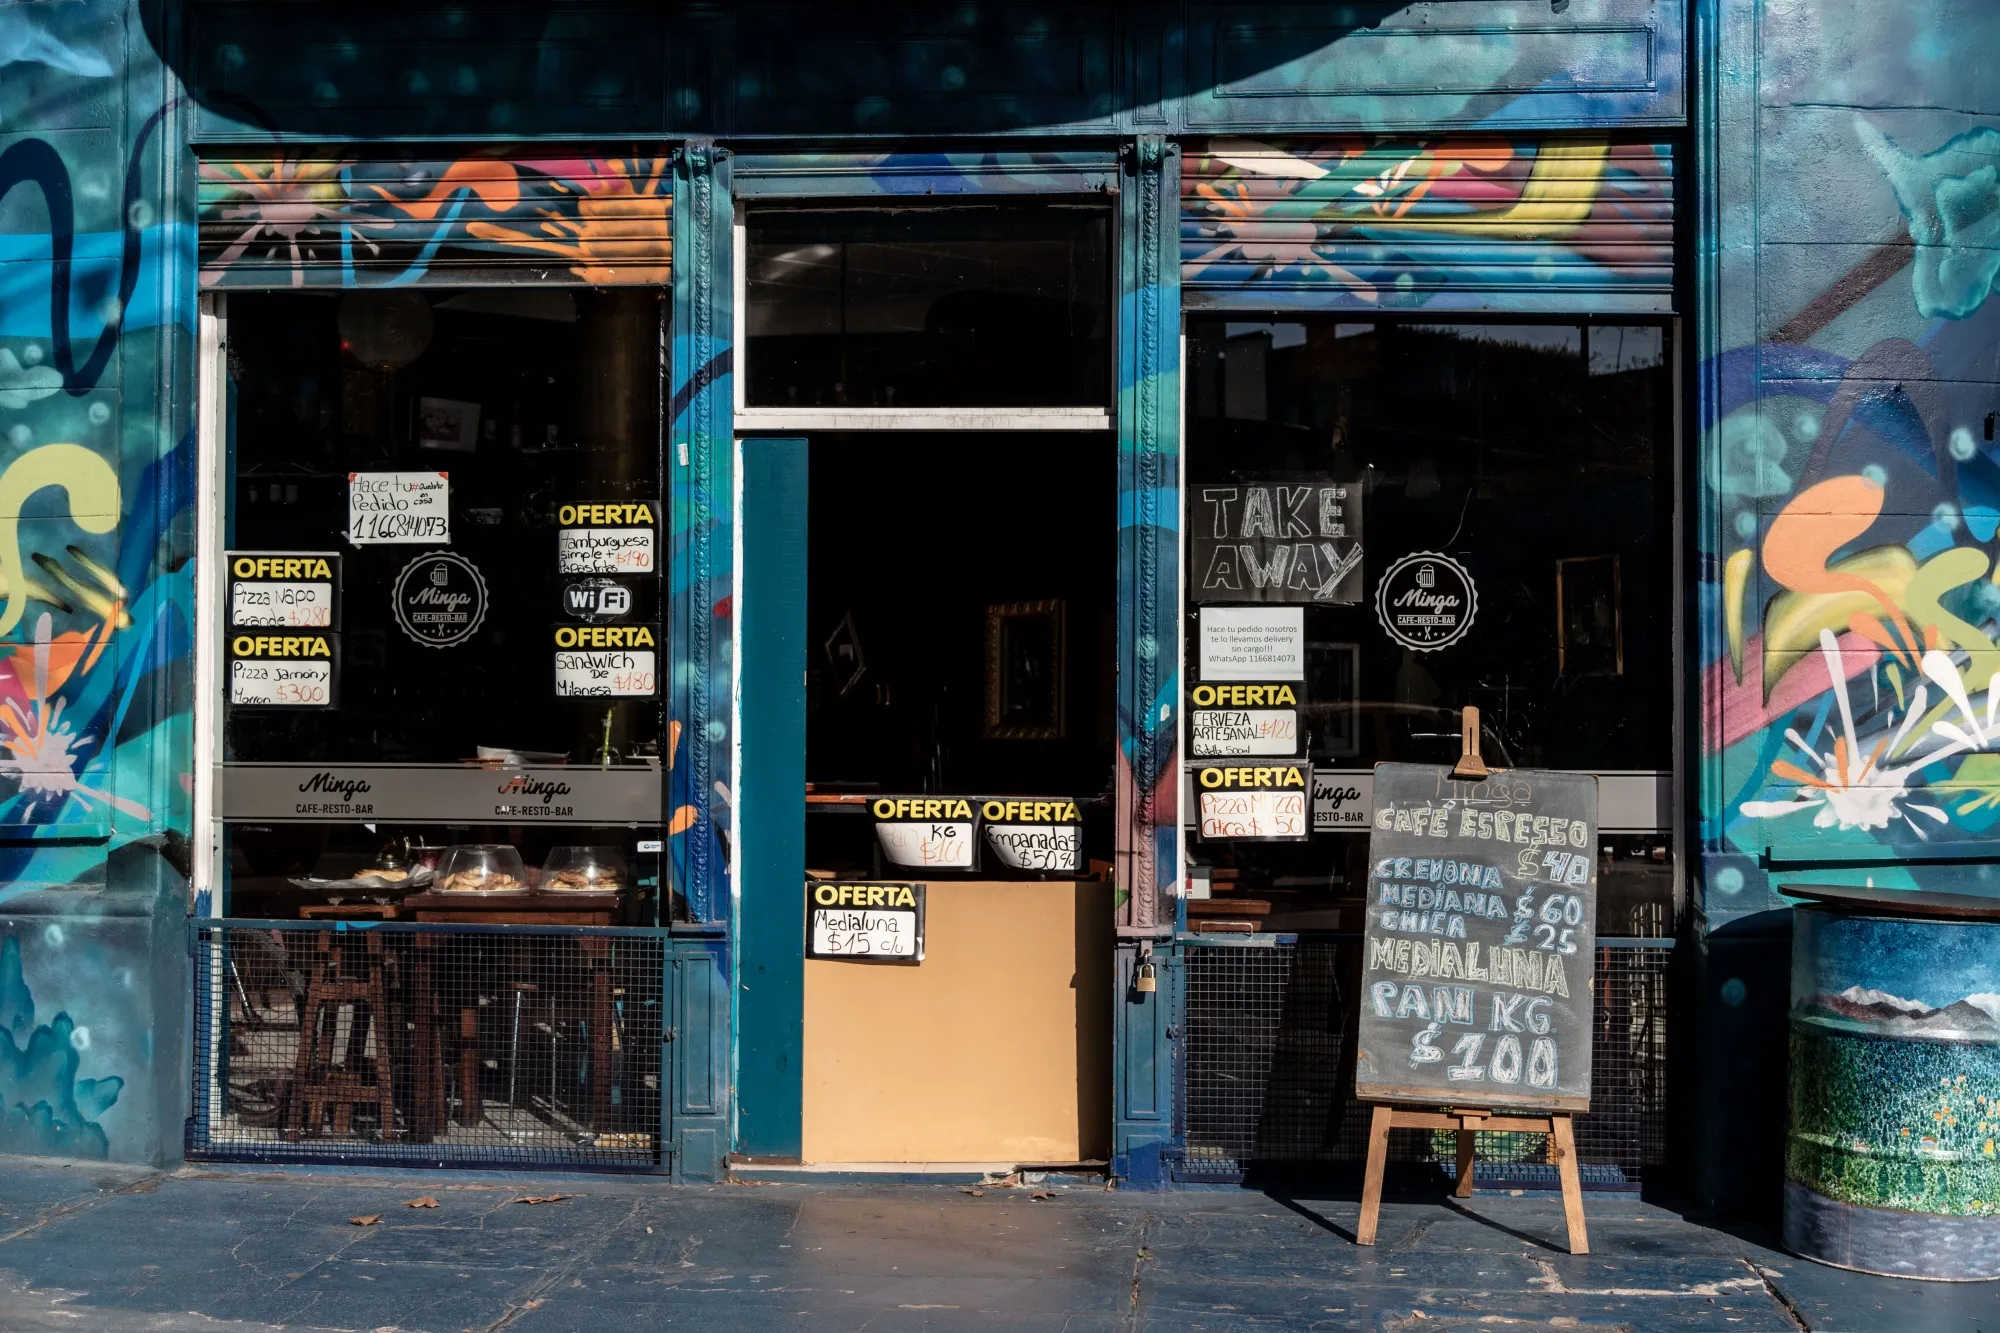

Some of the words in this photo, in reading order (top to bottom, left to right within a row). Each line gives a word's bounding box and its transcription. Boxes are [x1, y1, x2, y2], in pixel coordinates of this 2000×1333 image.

[353, 476, 389, 492] Hace
[393, 475, 412, 492] tu
[352, 493, 408, 511] Pedido
[414, 497, 433, 505] casa
[559, 504, 654, 525] OFERTA
[1203, 486, 1347, 538] TAKE
[560, 530, 649, 550] Hamburguesa
[560, 547, 602, 562] simple
[615, 550, 649, 567] $190
[234, 558, 332, 578] OFERTA
[1203, 542, 1363, 600] AWAY
[234, 583, 271, 606] Pizza
[275, 588, 316, 608] Napo
[409, 587, 471, 612] Minga
[1393, 588, 1460, 615] Minga
[233, 608, 286, 627] Grande
[555, 627, 655, 647] OFERTA
[1220, 635, 1228, 643] lo
[1229, 635, 1262, 643] llevamos
[1263, 635, 1294, 644] delivery
[1237, 625, 1263, 634] pedido
[233, 636, 331, 657] OFERTA
[1231, 645, 1242, 653] sin
[1243, 645, 1273, 654] cargo!!!
[556, 652, 634, 670] Sandwich
[1208, 655, 1247, 664] WhatsApp
[1249, 655, 1296, 663] 1166814073
[234, 662, 269, 680] Pizza
[557, 681, 612, 696] Milanesa
[613, 672, 655, 691] $180
[277, 684, 323, 703] $300
[1192, 685, 1296, 706] OFERTA
[1193, 712, 1251, 727] CERVEZA
[1259, 718, 1296, 740] $120
[1193, 724, 1265, 741] ARTESANAL
[299, 772, 371, 802] Minga
[1200, 767, 1304, 788] OFERTA
[498, 774, 571, 804] Minga
[1313, 779, 1361, 810] inga
[1436, 769, 1532, 809] Minga
[296, 804, 373, 814] CAFE-RESTO-BAR
[495, 806, 574, 816] CAFE-RESTO-BAR
[874, 799, 973, 819] OFERTA
[982, 801, 1082, 822] OFERTA
[1201, 793, 1248, 815] Pizza
[931, 824, 957, 841] KG
[985, 826, 1083, 853] Empanadas
[1018, 848, 1057, 870] $50
[1373, 857, 1504, 889] CREMONA
[814, 885, 916, 907] OFERTA
[815, 911, 901, 933] Medialuna
[828, 931, 871, 955] $15
[1370, 981, 1474, 1025] PAN
